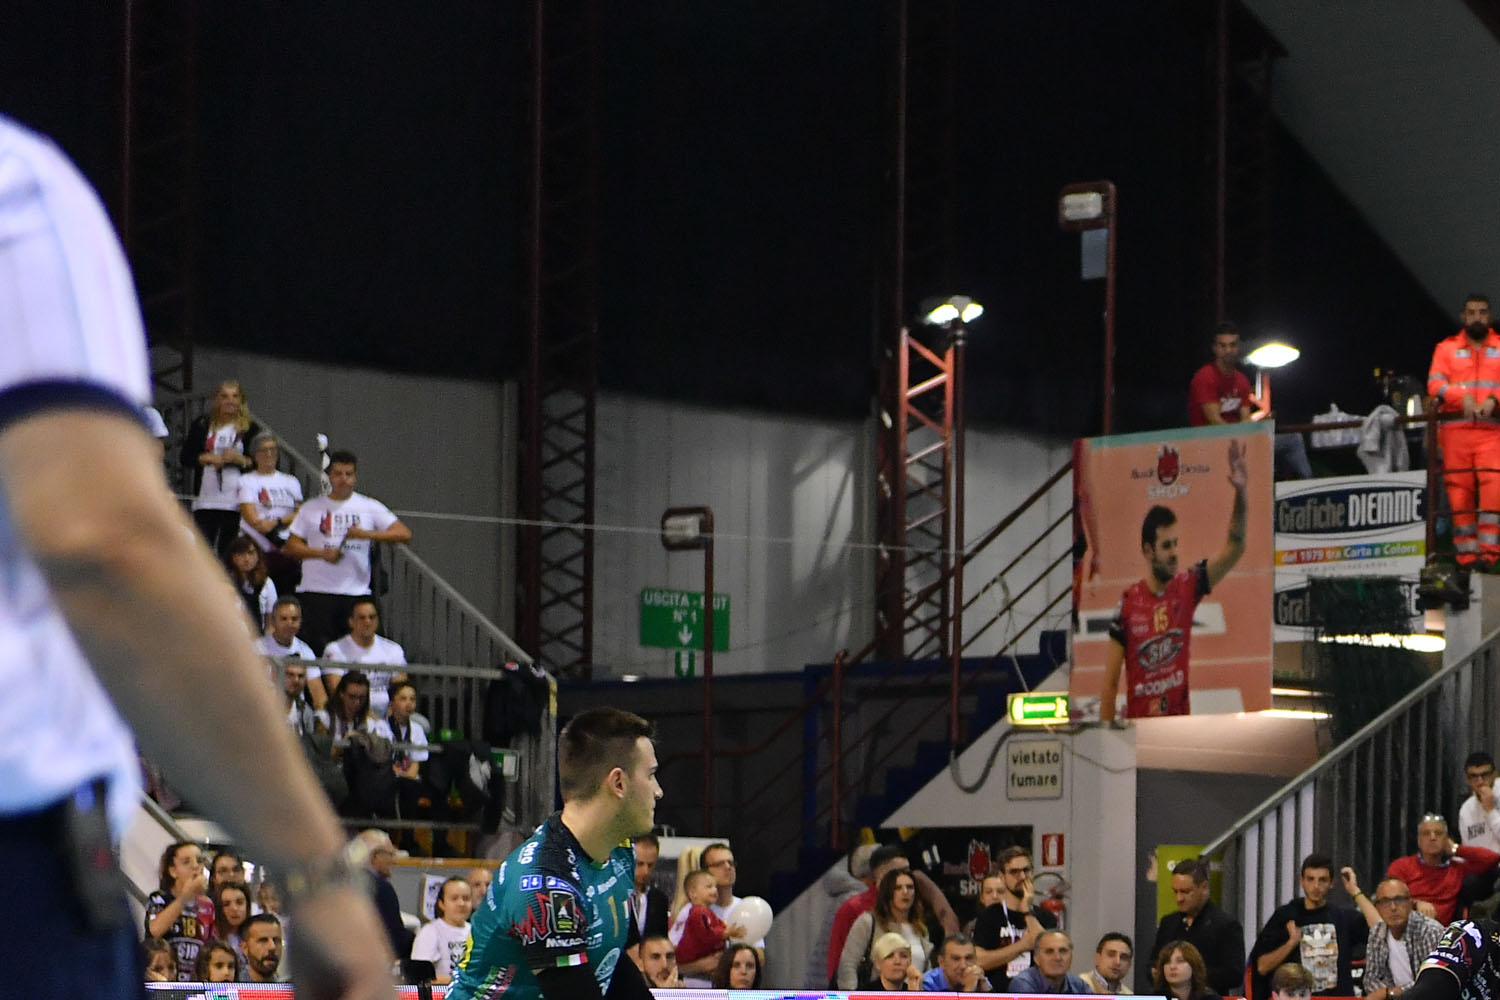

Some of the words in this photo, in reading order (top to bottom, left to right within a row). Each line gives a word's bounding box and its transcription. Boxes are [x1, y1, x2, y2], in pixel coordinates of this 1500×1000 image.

[1278, 498, 1346, 532] Grafiche
[1347, 488, 1423, 527] DIEMME
[1300, 549, 1325, 562] 1979
[643, 590, 690, 607] USCITA
[1011, 749, 1060, 765] vietato
[1011, 773, 1058, 788] fumare
